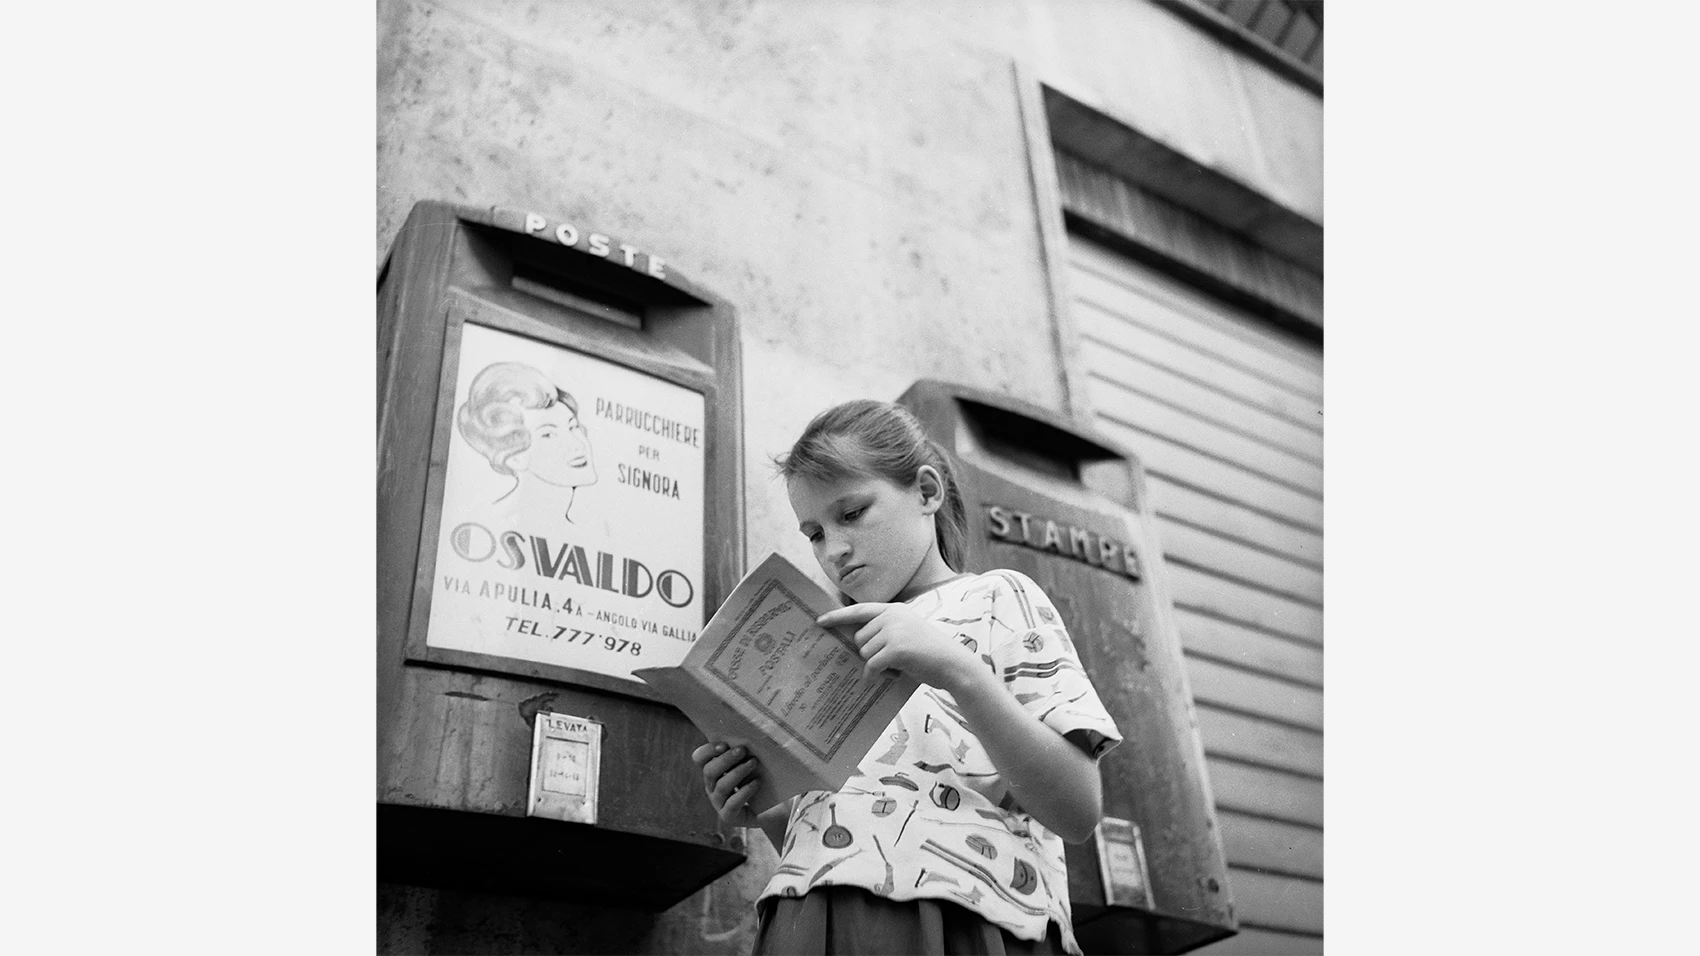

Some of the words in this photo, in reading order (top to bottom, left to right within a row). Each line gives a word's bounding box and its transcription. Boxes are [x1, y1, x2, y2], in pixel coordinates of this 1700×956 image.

[525, 212, 666, 280] POSTE
[595, 397, 700, 449] PARRUCCHIERE
[617, 462, 680, 500] SIGNORA
[638, 445, 660, 462] PER
[450, 521, 694, 608] OSVALDO
[989, 506, 1140, 574] STAMPE
[443, 576, 471, 595] VIA
[641, 620, 659, 635] VIA
[662, 625, 698, 643] GALLIA
[546, 719, 588, 732] LEVATA
